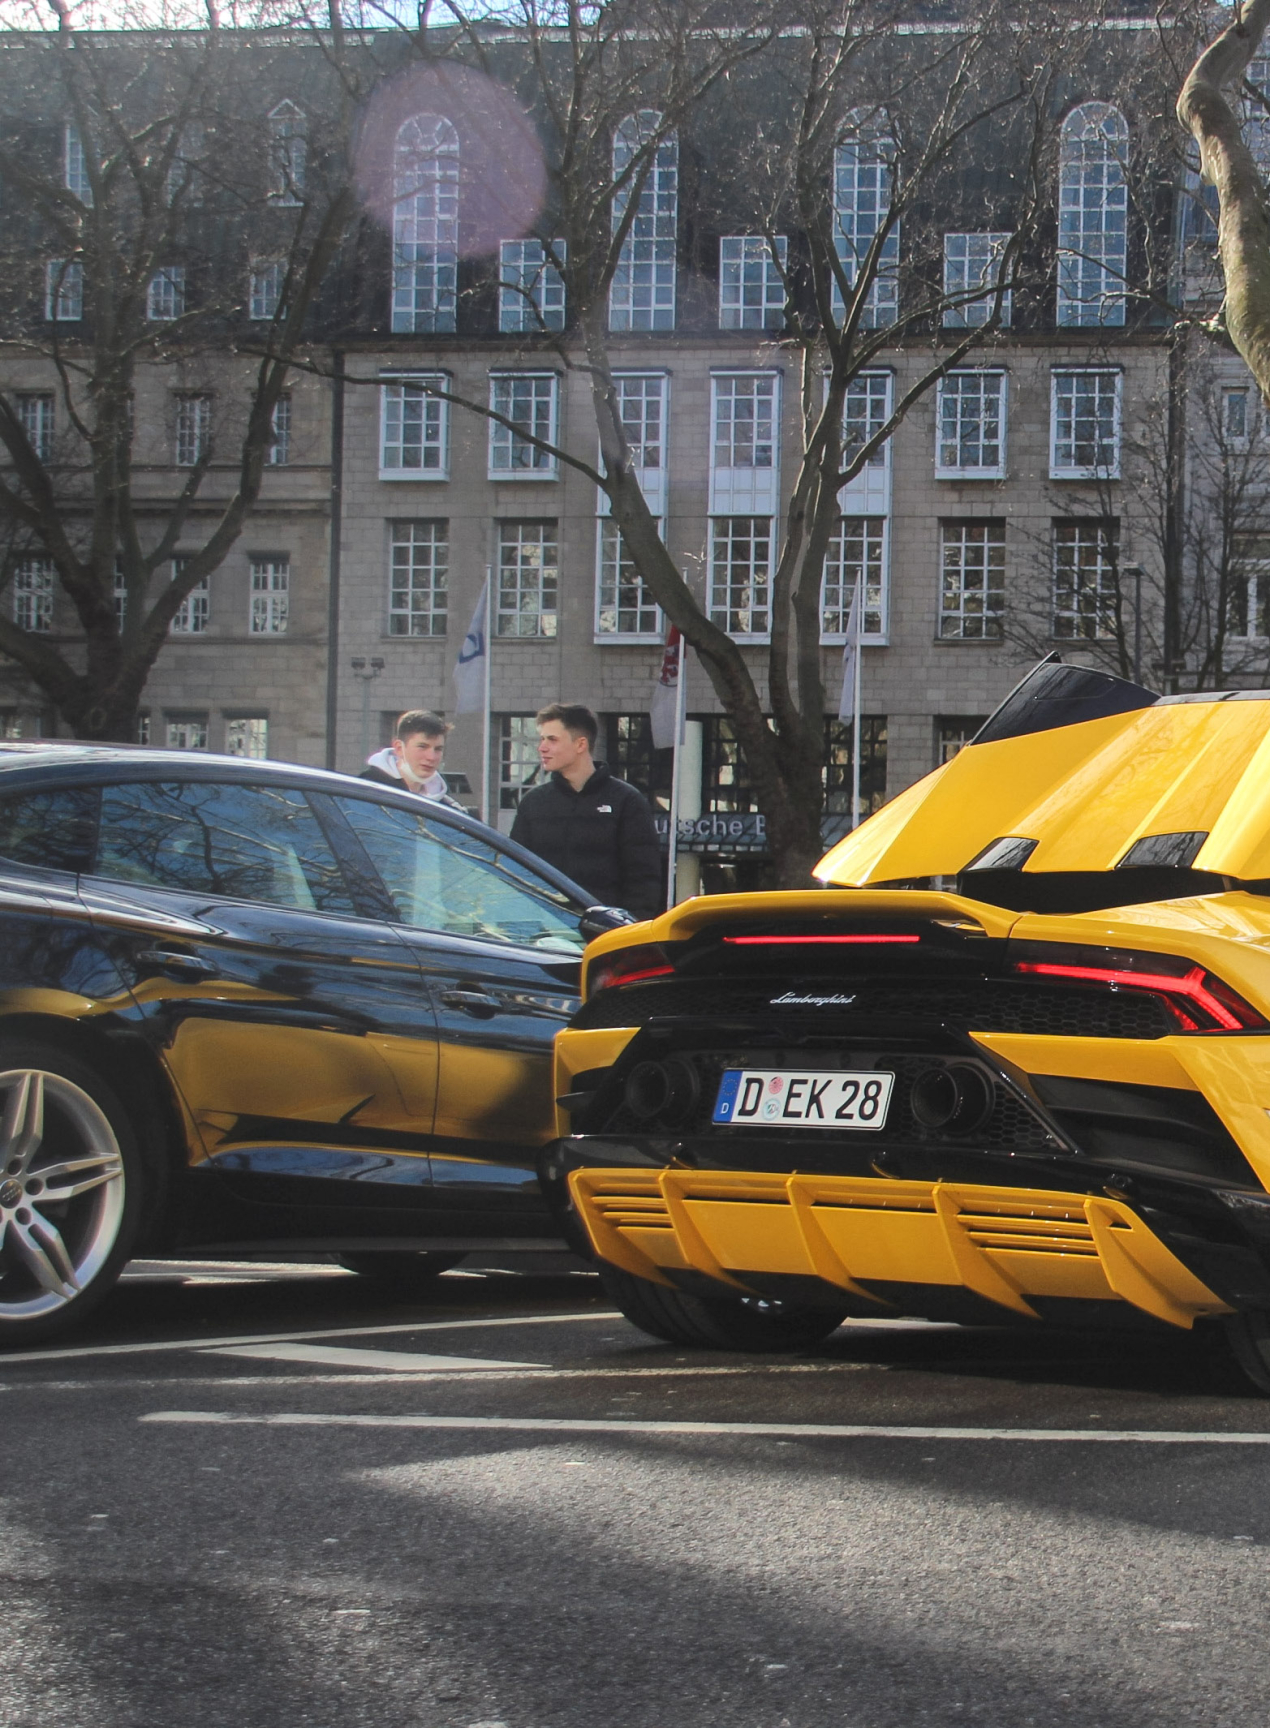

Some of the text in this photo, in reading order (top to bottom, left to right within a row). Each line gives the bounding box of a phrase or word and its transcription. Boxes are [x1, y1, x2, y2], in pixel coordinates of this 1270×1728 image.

[769, 991, 857, 1007] Lamborghini
[738, 1077, 882, 1121] D EK 28
[720, 1102, 730, 1115] D
